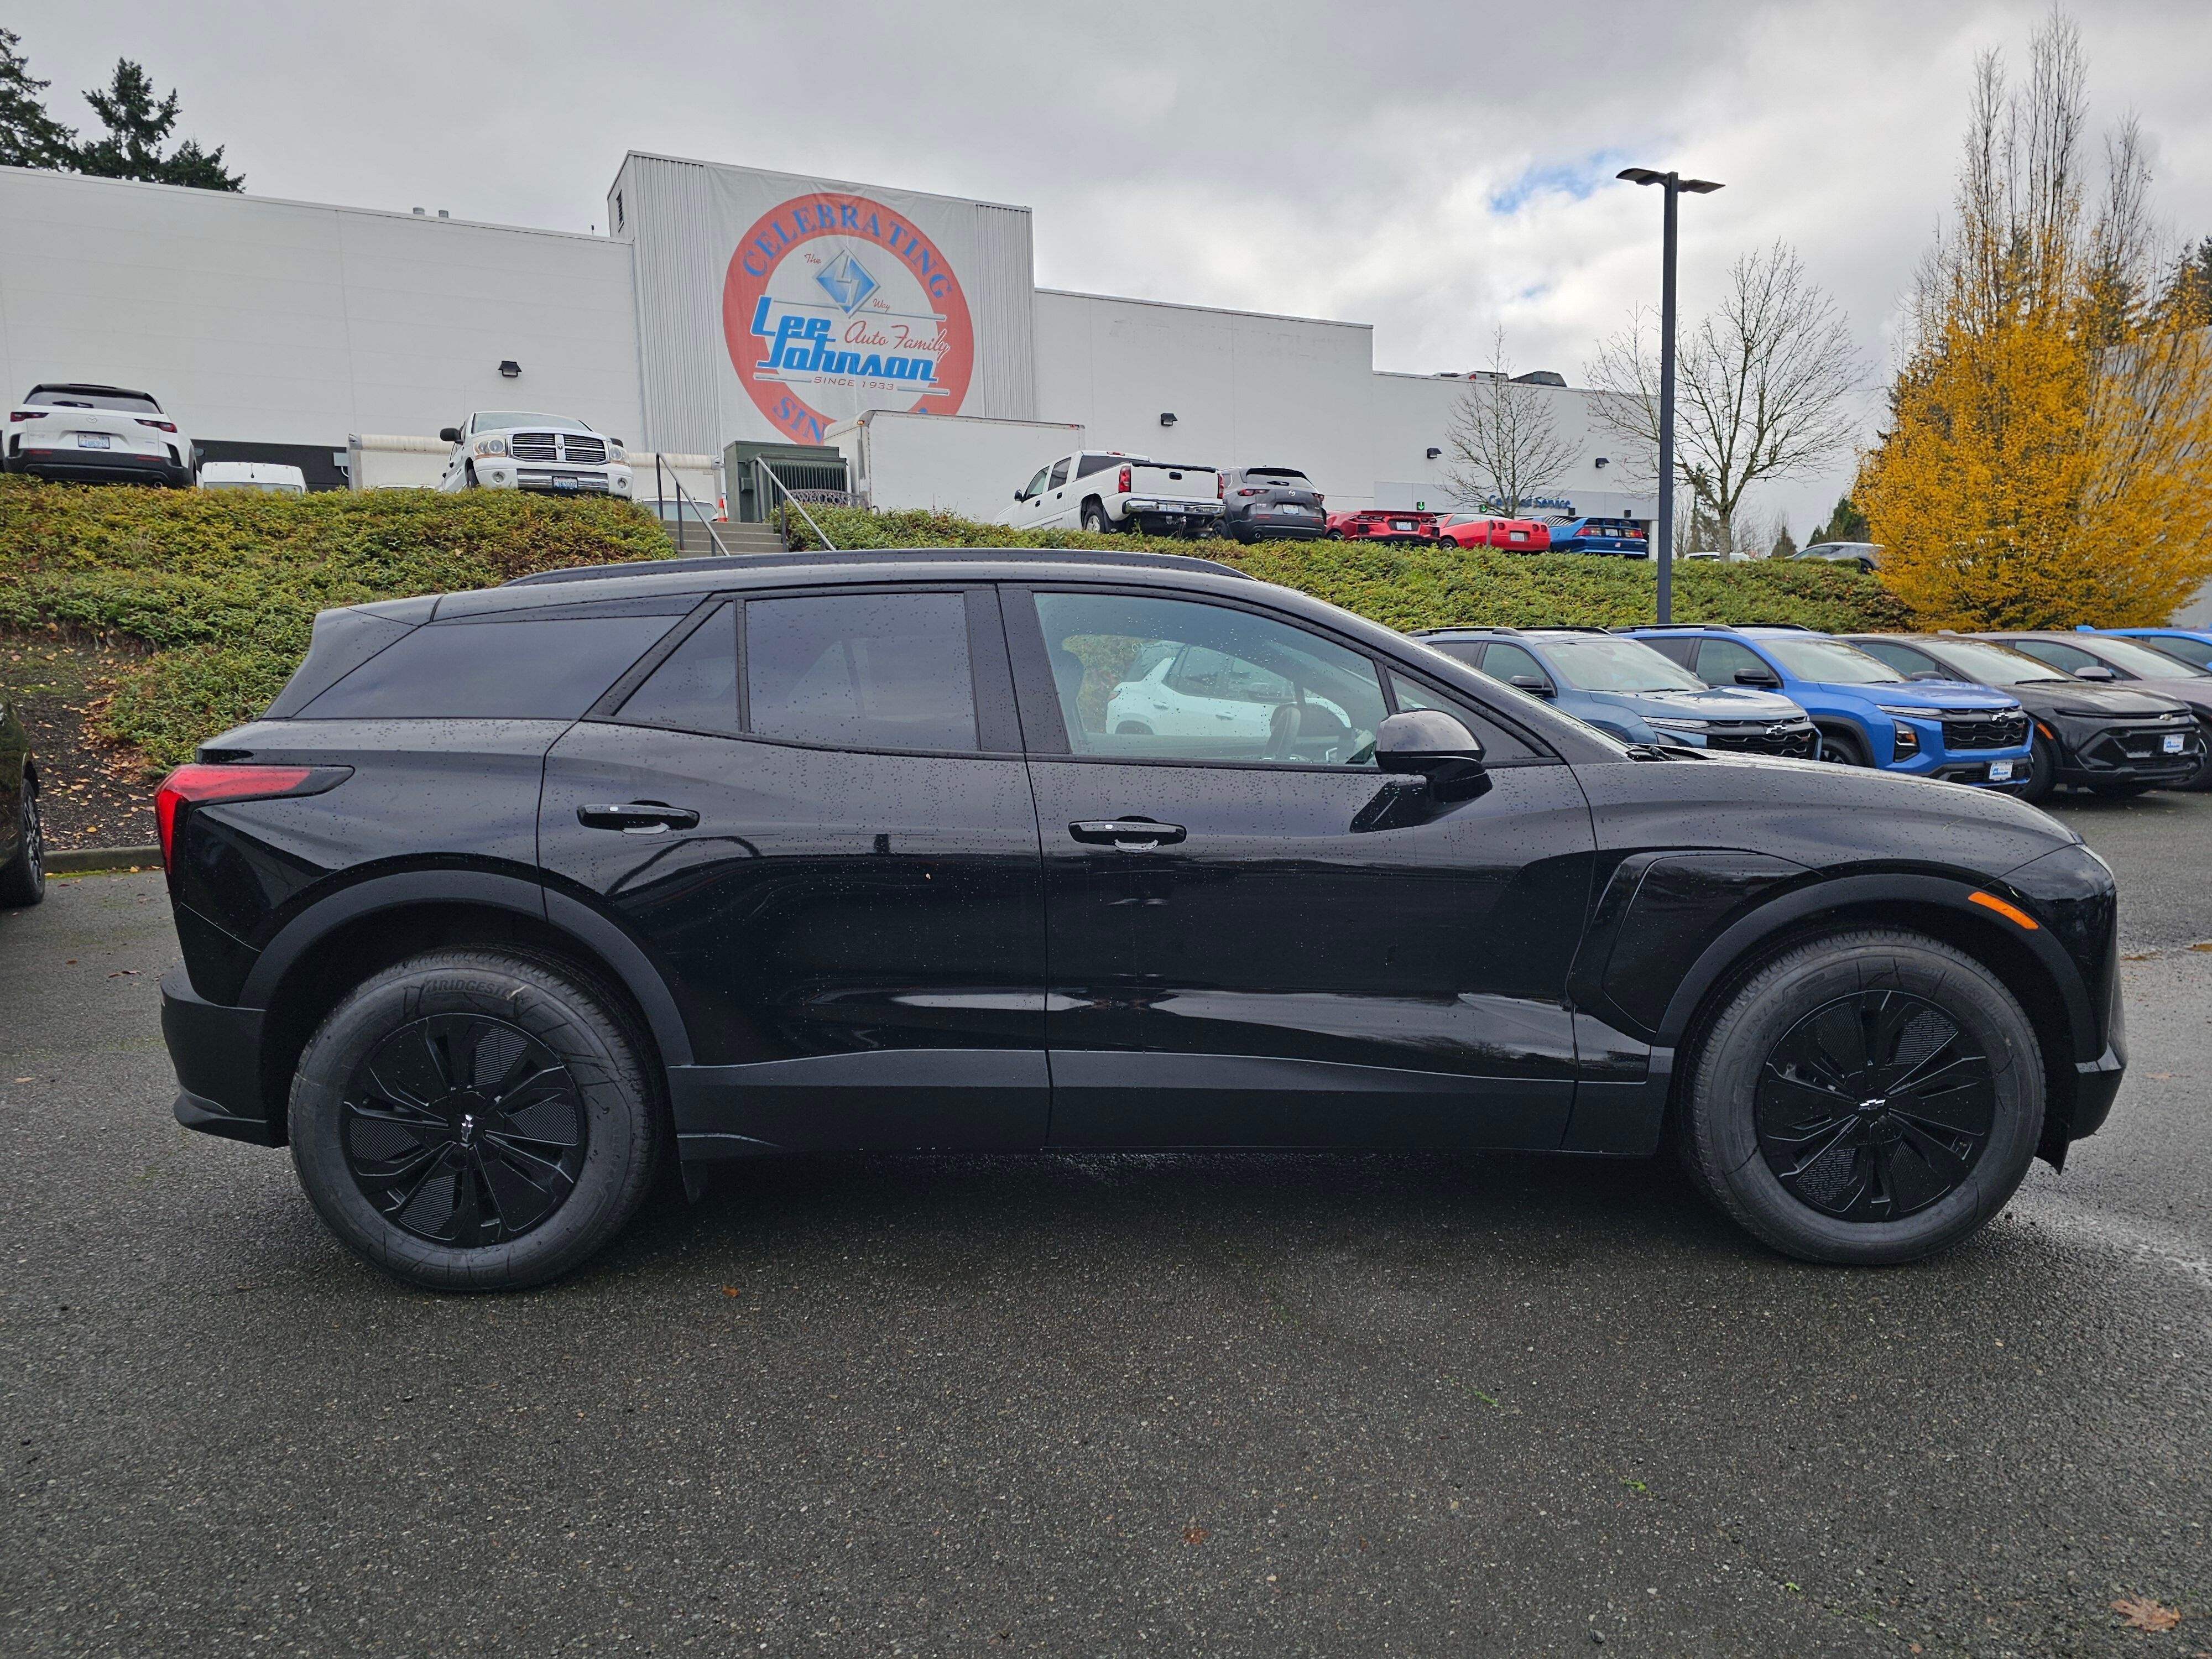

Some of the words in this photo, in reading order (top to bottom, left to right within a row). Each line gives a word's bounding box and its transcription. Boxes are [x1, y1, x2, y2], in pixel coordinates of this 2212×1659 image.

[743, 204, 952, 298] CELEBRATING
[804, 254, 821, 264] The
[873, 298, 890, 312] Way
[752, 296, 836, 342] Lee
[844, 321, 889, 346] Auto
[891, 325, 950, 362] Family
[756, 333, 938, 382] Johnson
[813, 377, 855, 387] SINCE
[862, 381, 894, 390] 1933
[773, 397, 827, 444] SIN
[1534, 497, 1571, 509] Service
